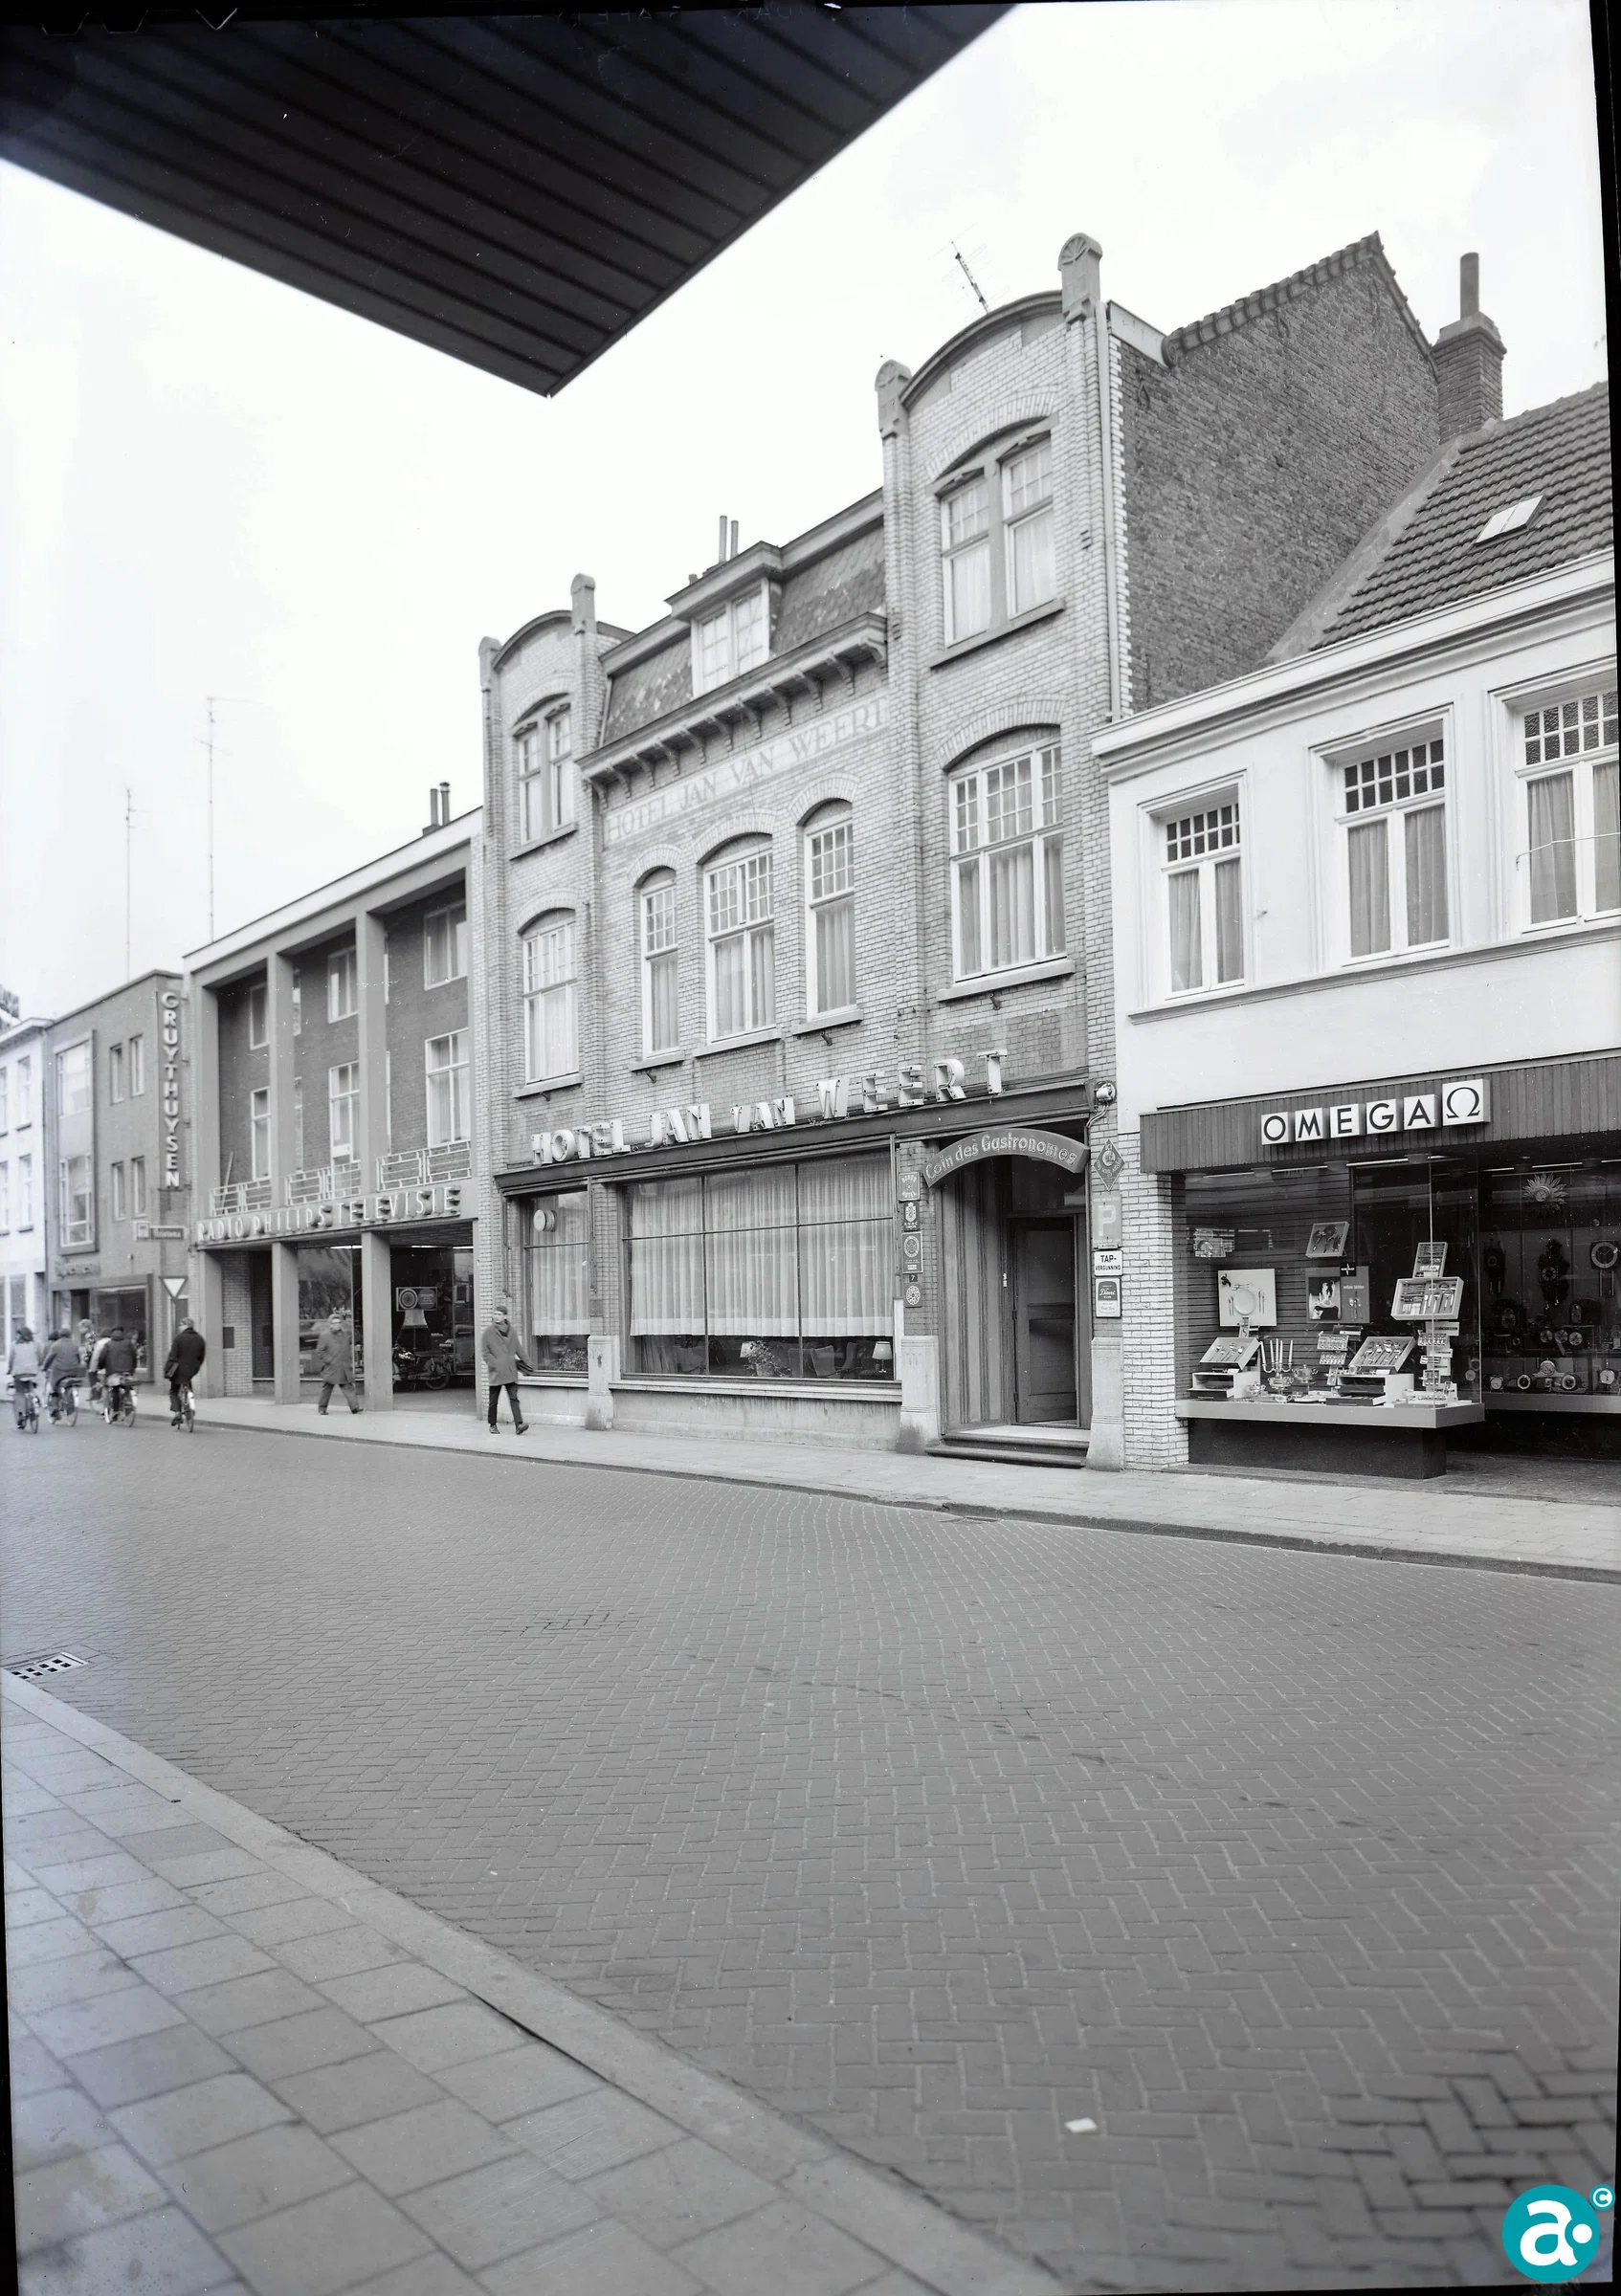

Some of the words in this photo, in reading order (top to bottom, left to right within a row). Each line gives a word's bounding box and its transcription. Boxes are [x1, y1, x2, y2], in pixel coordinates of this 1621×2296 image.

[606, 796, 676, 842] HOTEL
[679, 775, 718, 811] JAN
[732, 746, 776, 784] VAN
[788, 697, 891, 762] WEERT
[161, 991, 180, 1189] GRUYTHUYSEN
[531, 1118, 632, 1166] HOTEL
[644, 1103, 712, 1149] JAN
[730, 1096, 796, 1134] VAN
[815, 1049, 1009, 1119] WEERT
[1262, 1098, 1432, 1141] OMEGA
[924, 1154, 958, 1181] Coin
[954, 1141, 980, 1163] des
[981, 1133, 1078, 1167] Gastronomes
[196, 1216, 244, 1242] RADIO
[251, 1204, 326, 1238] PHILIPS
[337, 1185, 459, 1225] TELEVISIE
[1098, 1204, 1117, 1237] P
[1099, 1254, 1118, 1264] TAP-
